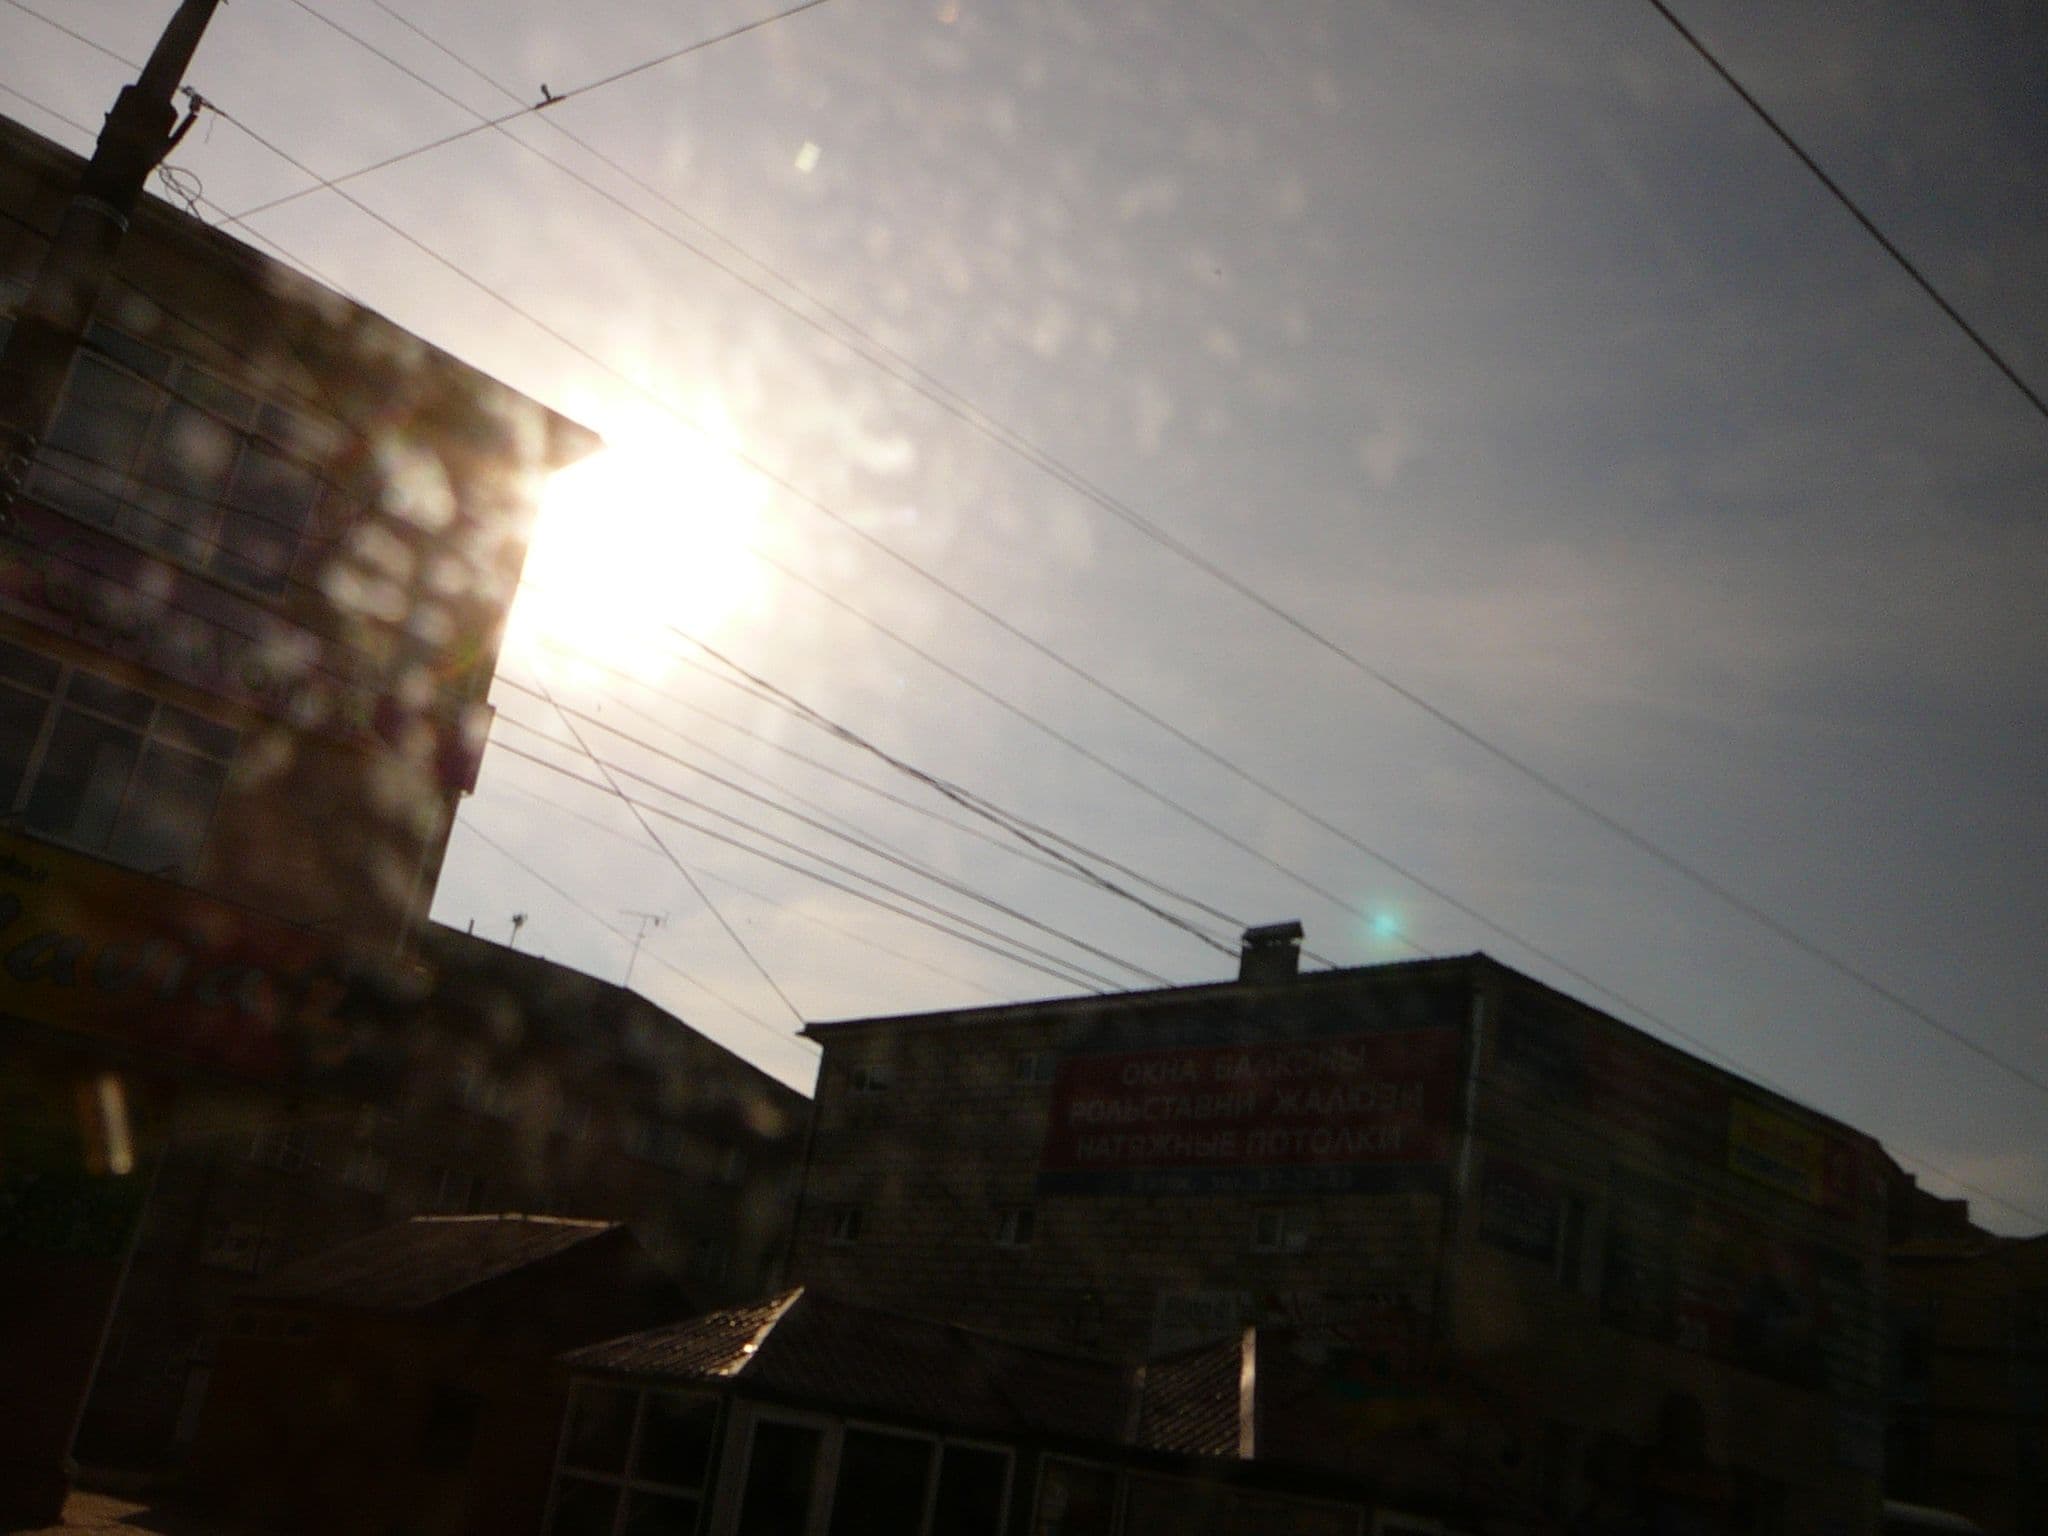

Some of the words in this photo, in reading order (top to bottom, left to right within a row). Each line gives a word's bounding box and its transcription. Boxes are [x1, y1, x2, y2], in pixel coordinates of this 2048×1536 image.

[1120, 1060, 1199, 1086] ОКНА
[1214, 1046, 1366, 1082] БАЛКОНЫ
[1069, 1090, 1256, 1126] РОЛЬСТАВНИ
[1271, 1082, 1423, 1116] ЖАЛЮЗИ
[1075, 1131, 1237, 1160] НАТЯЖНЫЕ
[1246, 1125, 1402, 1157] ПОТОЛКИ
